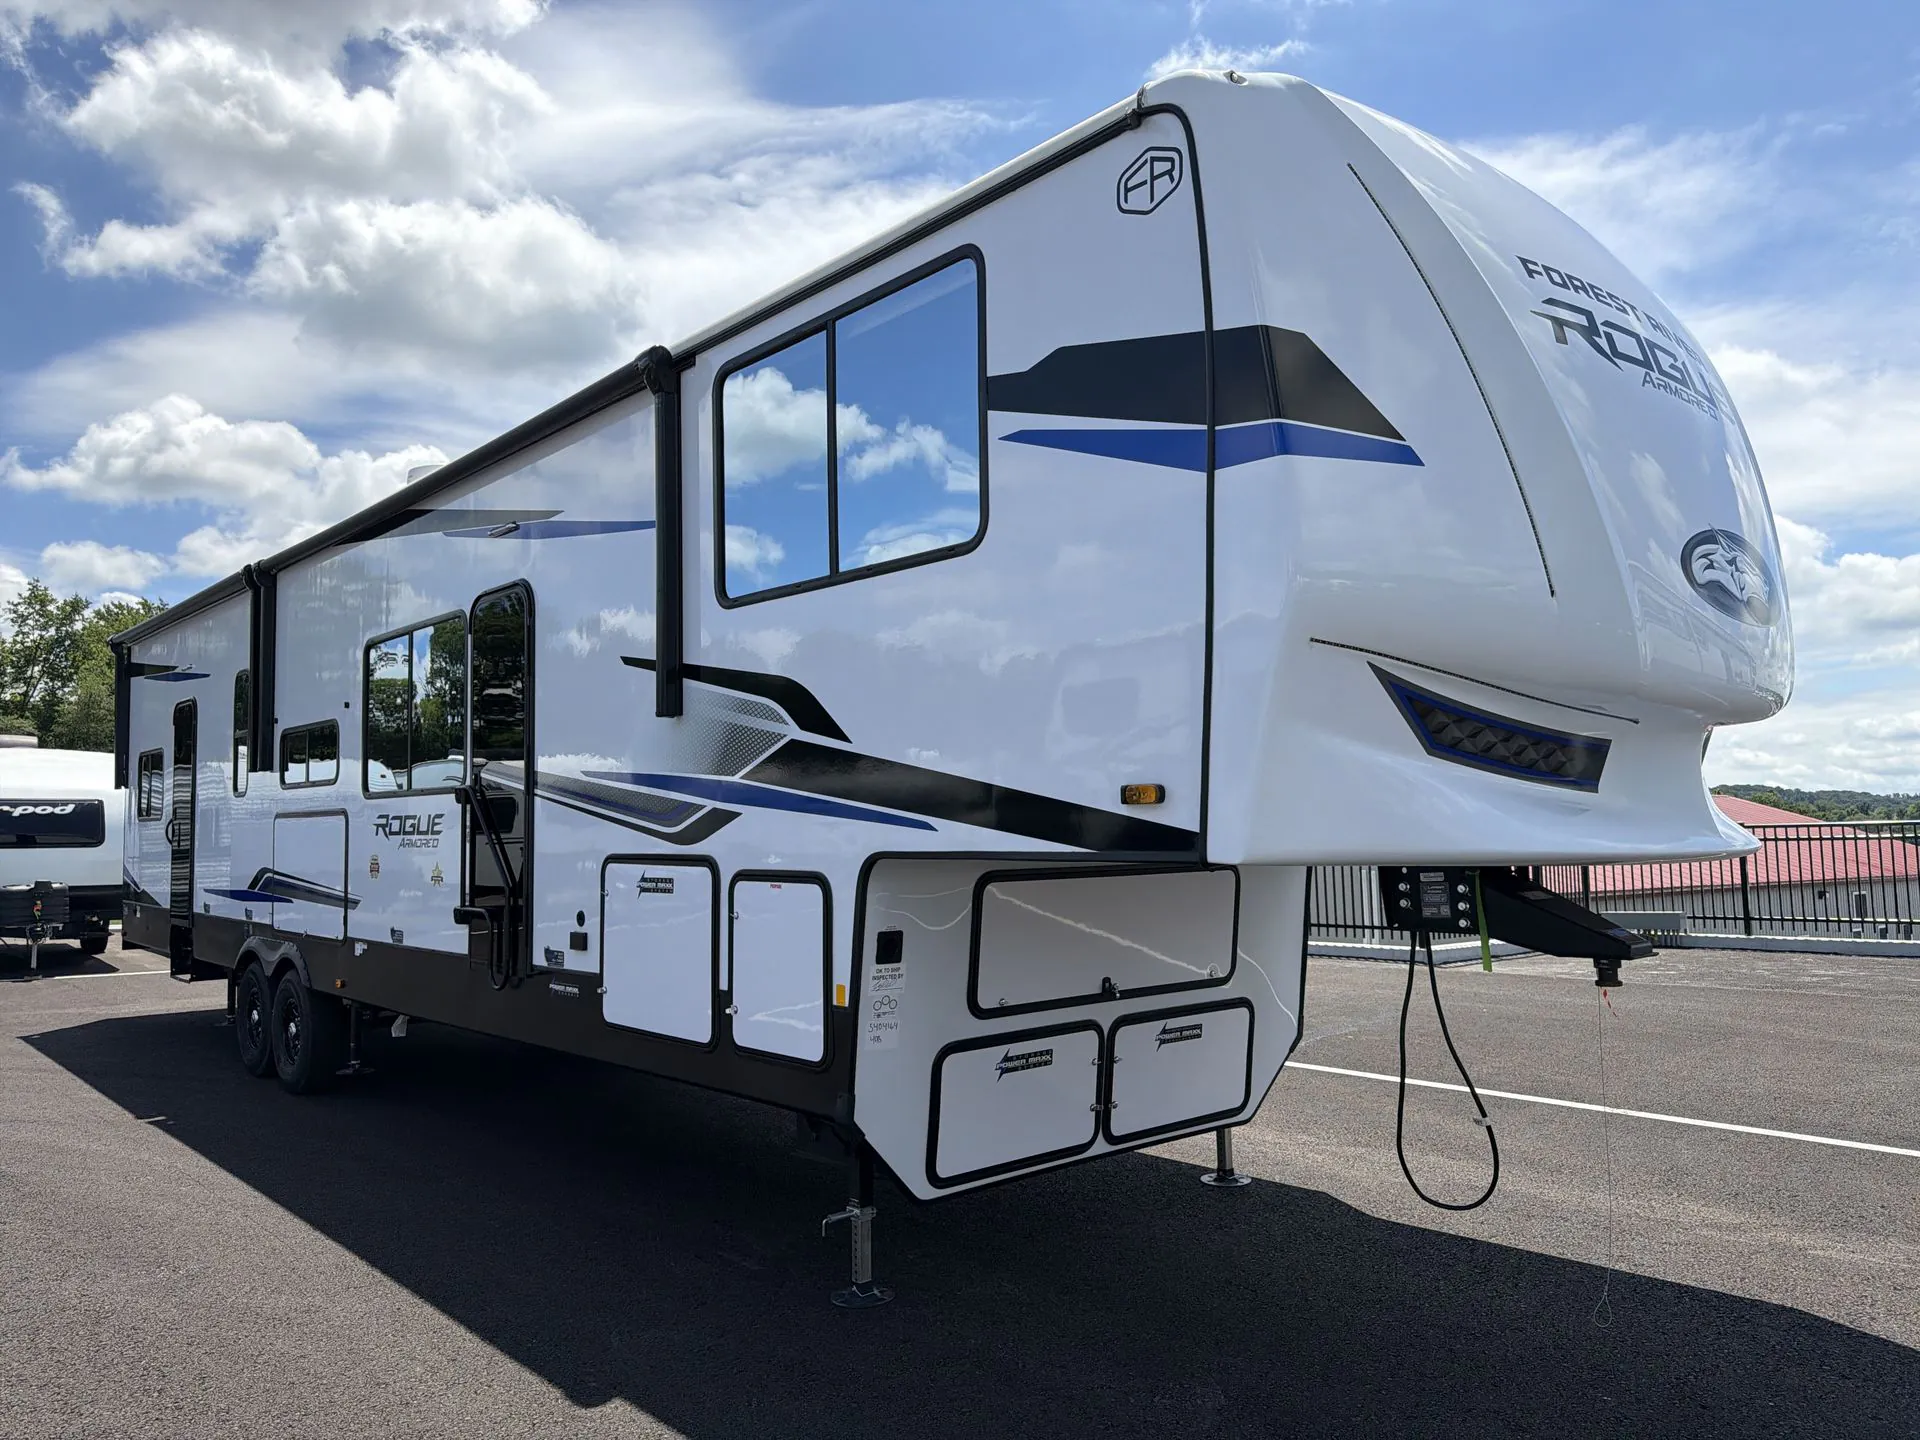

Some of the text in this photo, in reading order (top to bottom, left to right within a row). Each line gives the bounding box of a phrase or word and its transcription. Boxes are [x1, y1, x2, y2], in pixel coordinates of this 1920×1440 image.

[1516, 255, 1641, 323] FOREST
[1530, 297, 1735, 425] ROGUE
[1642, 371, 1718, 421] ARMORED
[372, 813, 446, 841] ROGUE
[398, 837, 440, 850] ARMORED
[996, 1055, 1051, 1069] POWER MAXX
